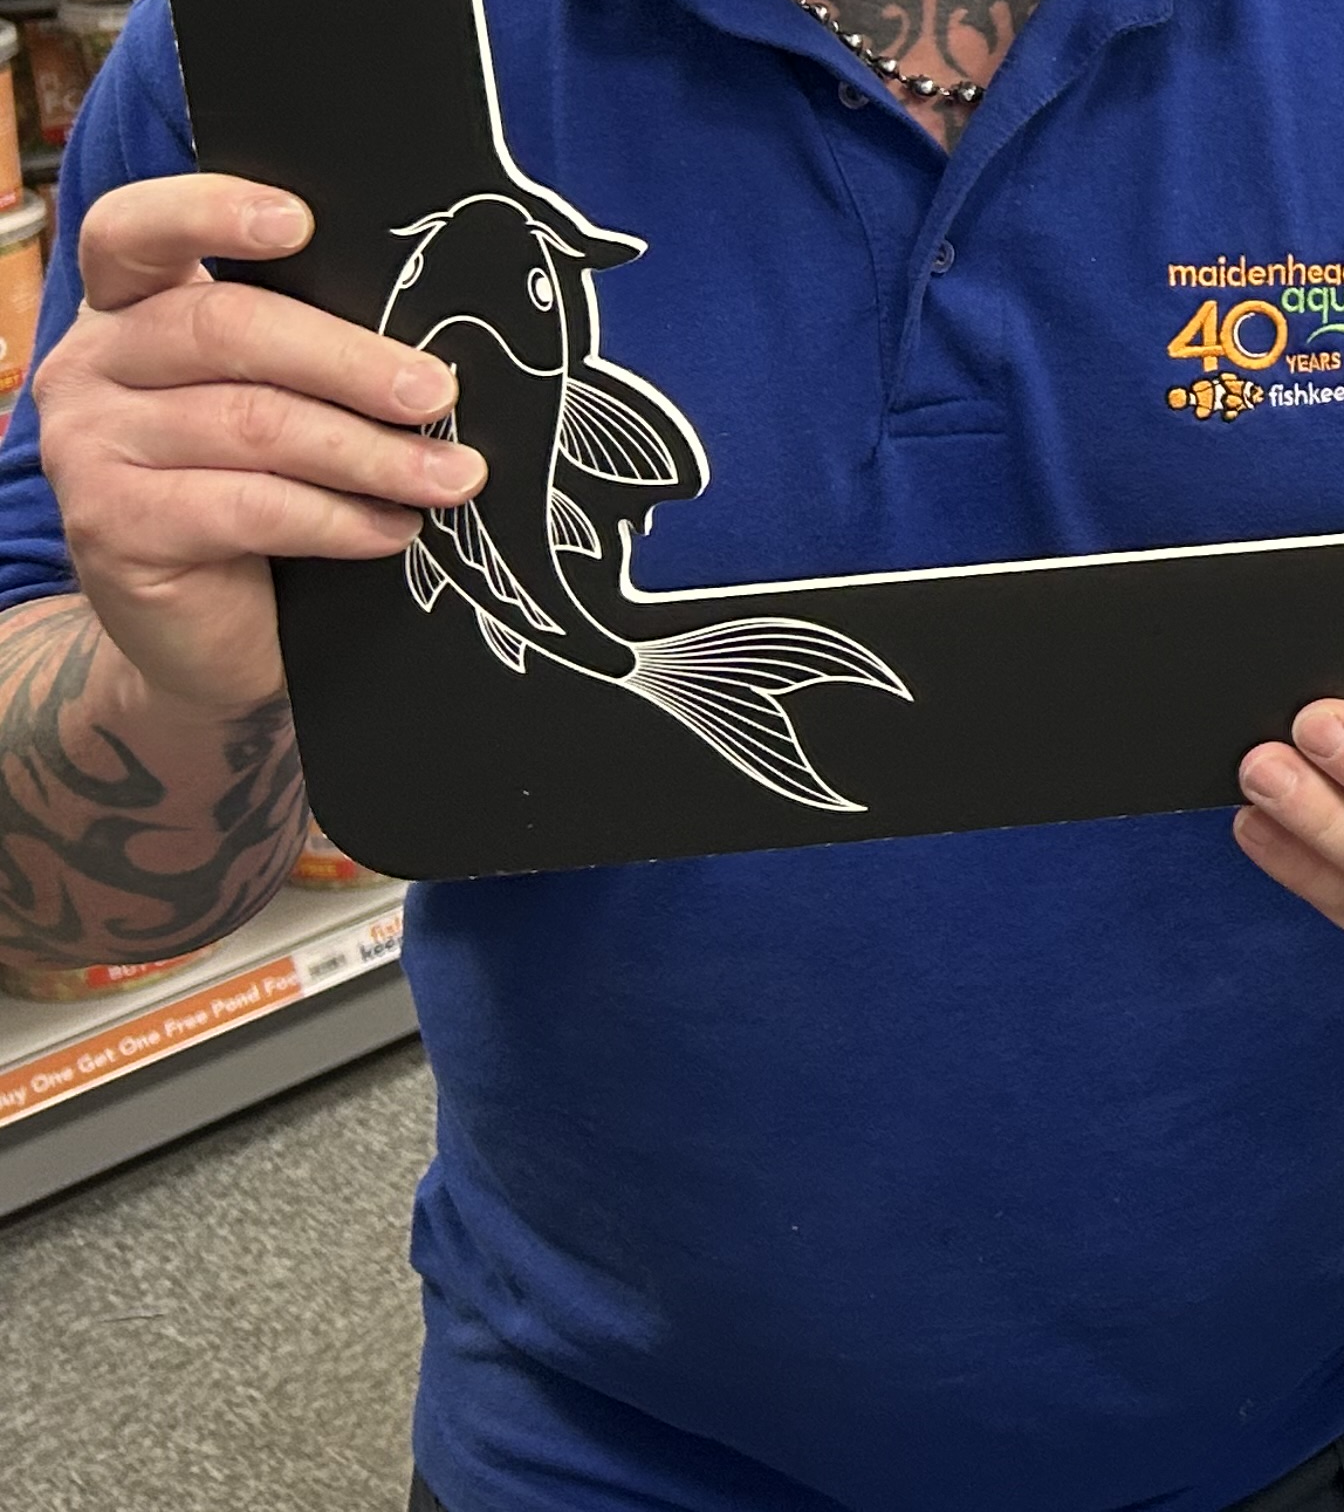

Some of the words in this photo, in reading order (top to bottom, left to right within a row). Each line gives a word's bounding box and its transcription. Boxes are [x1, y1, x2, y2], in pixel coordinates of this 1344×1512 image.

[1166, 299, 1289, 373] 40
[1285, 351, 1342, 374] YEARS
[0, 1084, 27, 1109] uy
[31, 1066, 73, 1094] One
[77, 1046, 117, 1075] Get
[118, 1029, 161, 1058] One
[164, 1009, 210, 1039] Free
[211, 984, 261, 1020] Pond
[263, 969, 300, 998] Foo
